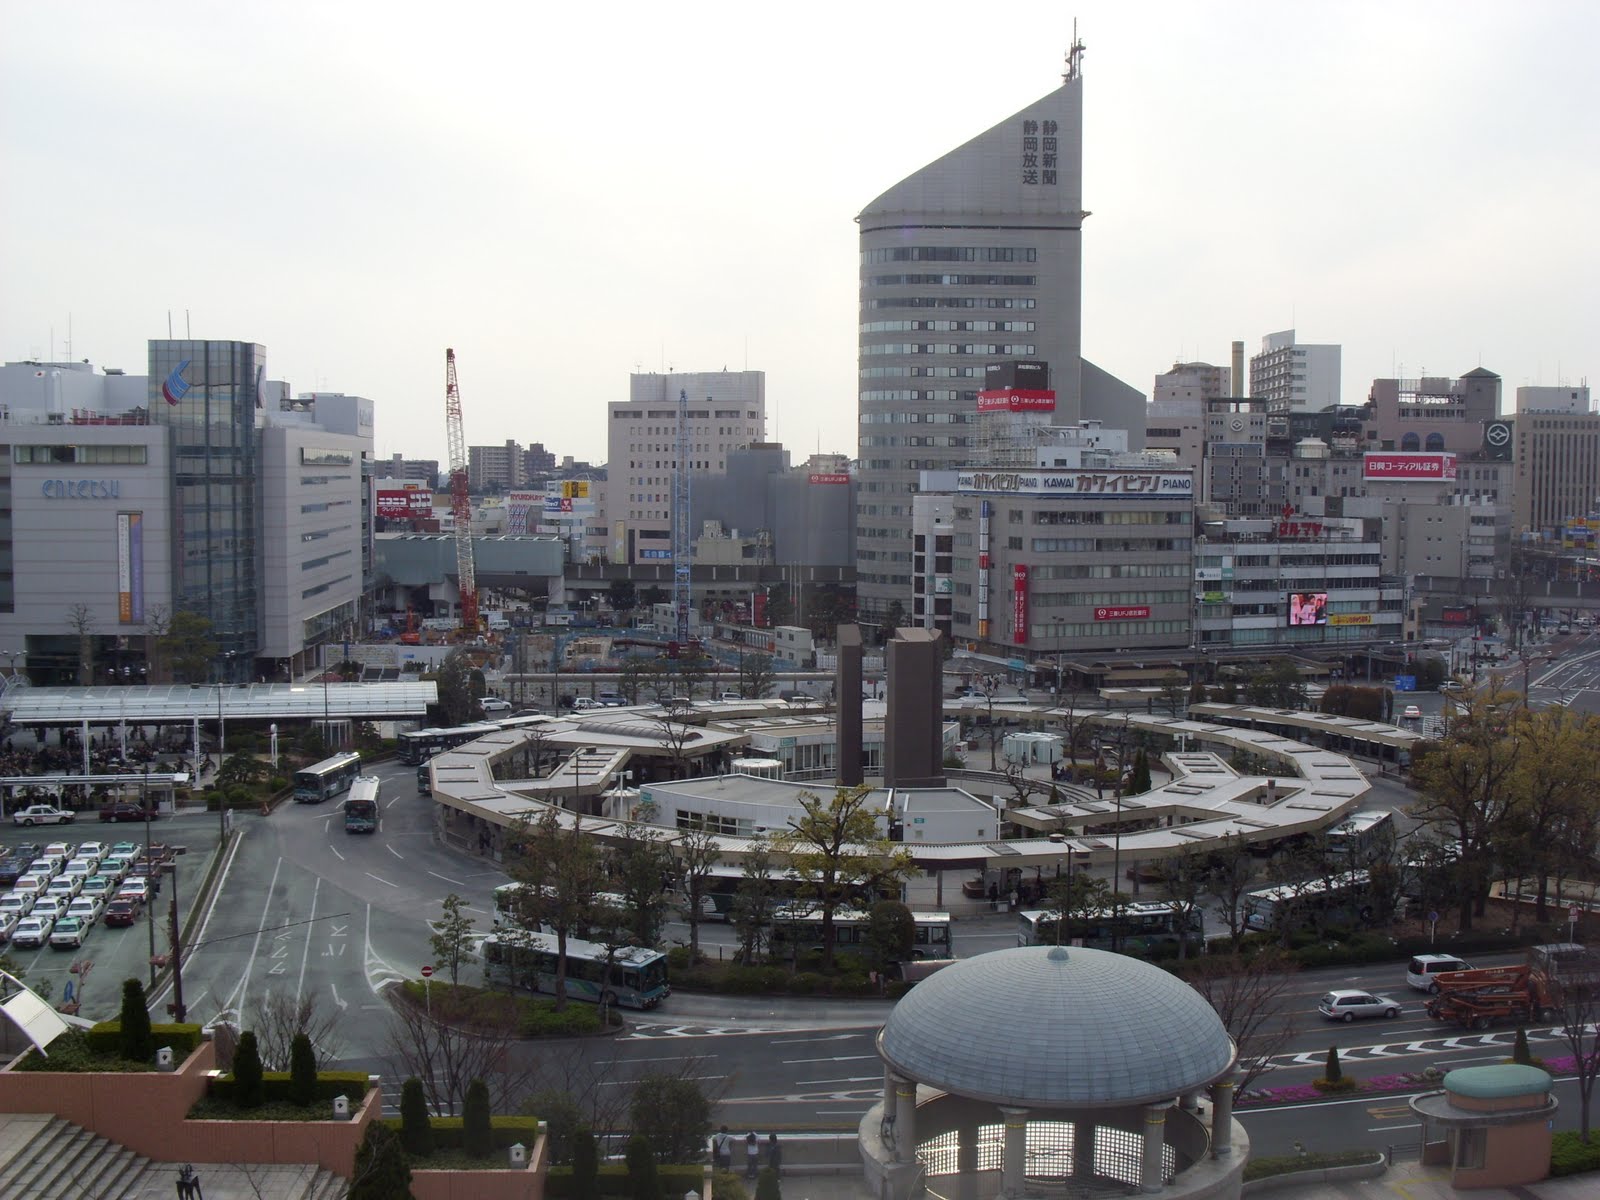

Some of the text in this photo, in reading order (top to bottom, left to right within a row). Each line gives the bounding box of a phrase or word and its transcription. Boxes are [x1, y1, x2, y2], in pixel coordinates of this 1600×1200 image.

[1022, 119, 1039, 185] 静岡放送
[1042, 119, 1058, 186] 静岡新聞
[1369, 462, 1440, 472] 日興コーディアル証券
[1020, 477, 1038, 488] PIANO
[1043, 474, 1191, 492] KAWAI カワイピアノ PIANO
[378, 497, 407, 505] ニコニコ
